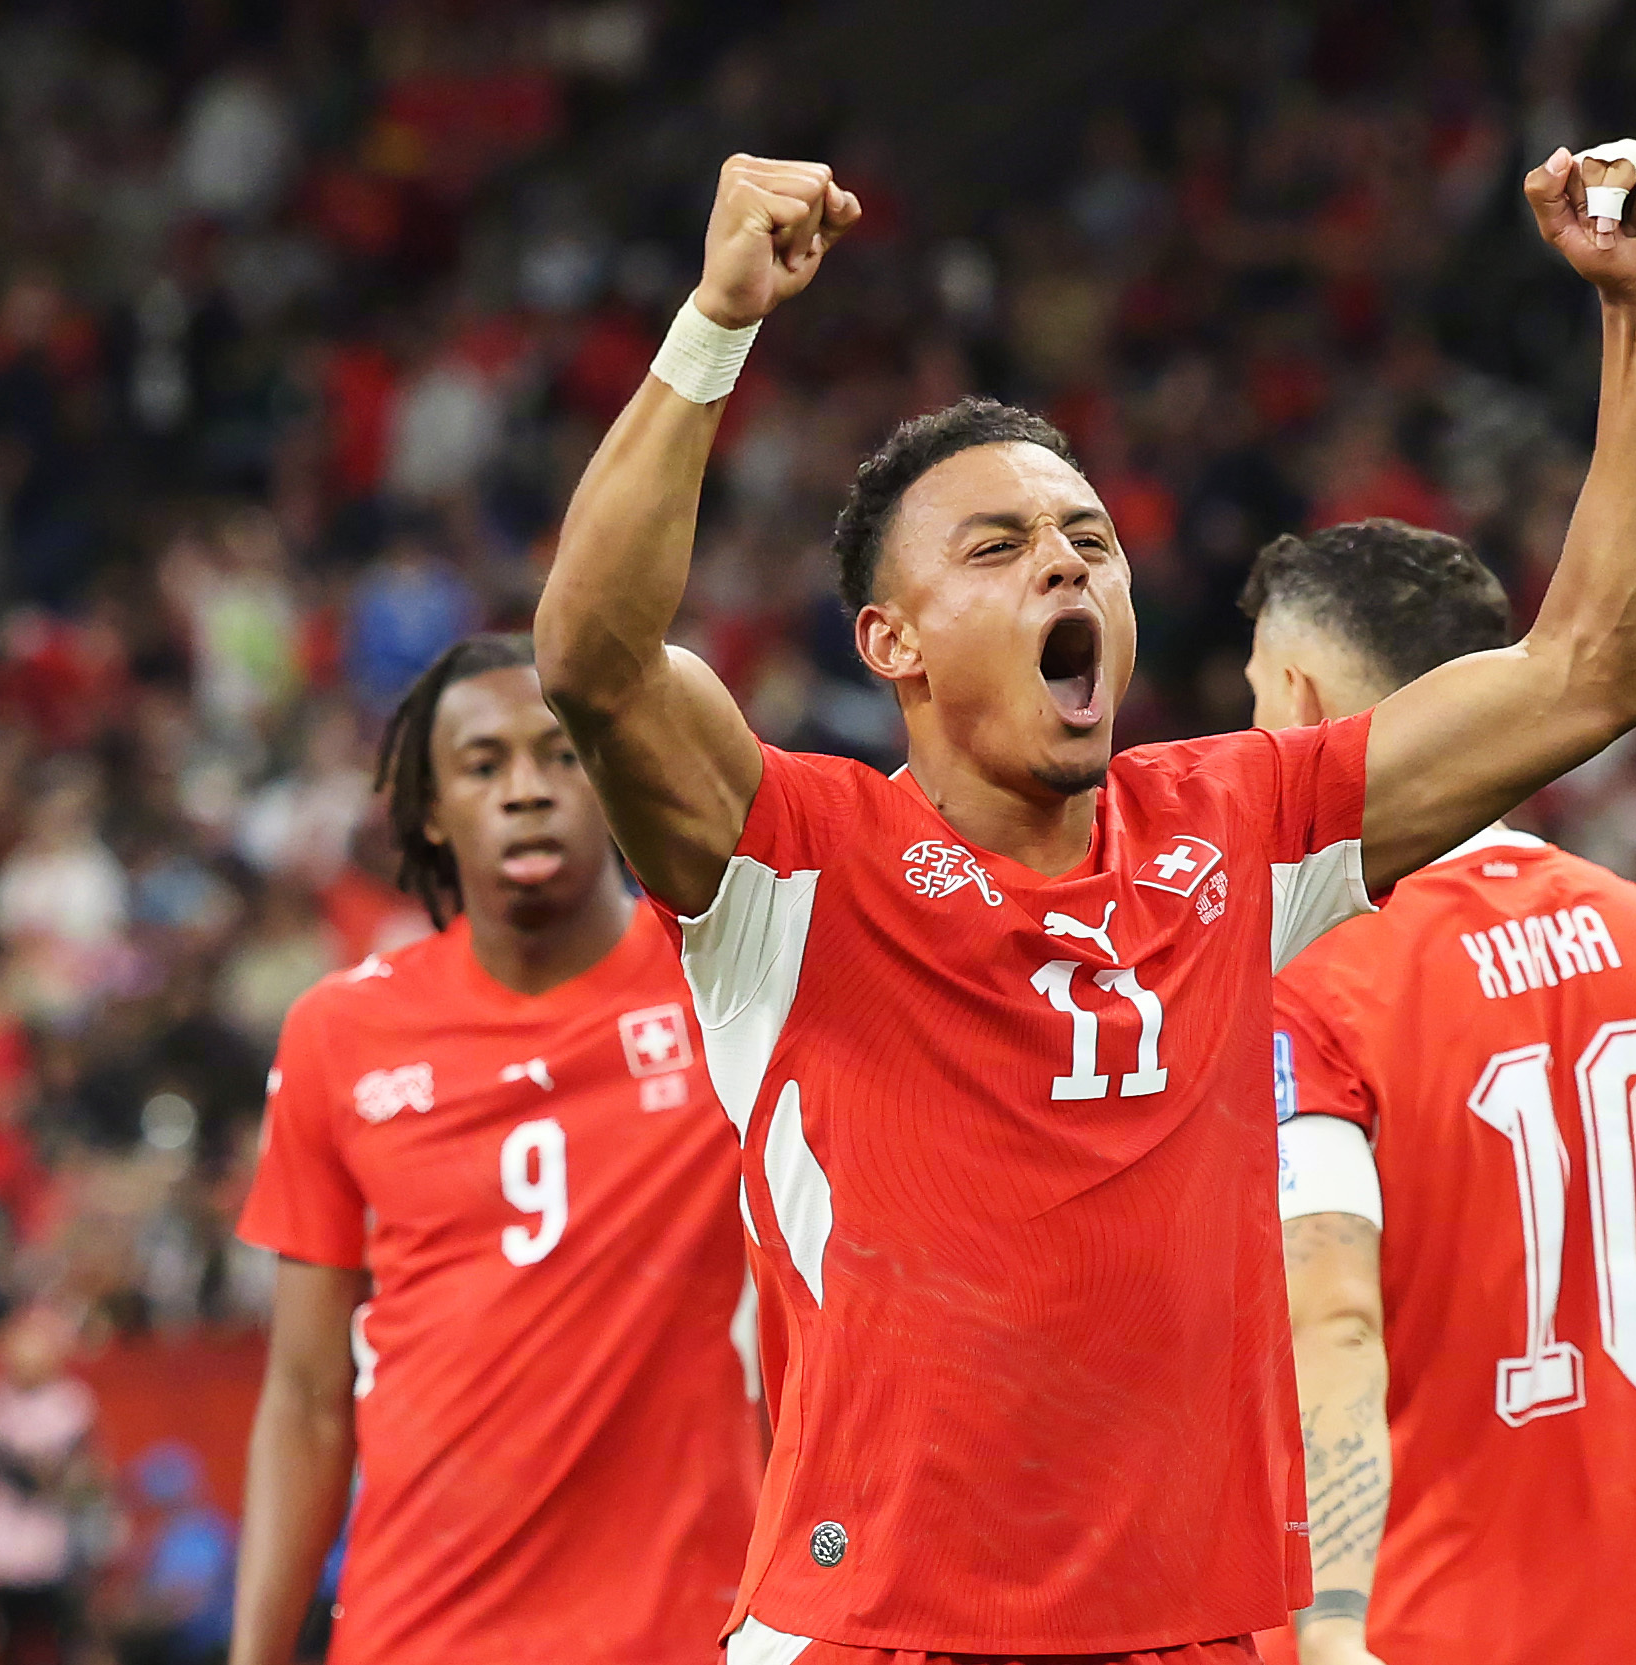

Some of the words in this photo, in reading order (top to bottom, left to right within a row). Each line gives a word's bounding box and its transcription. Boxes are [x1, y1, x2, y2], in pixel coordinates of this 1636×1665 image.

[1460, 905, 1623, 999] XHAKA
[1030, 959, 1168, 1101] 11
[499, 1118, 569, 1267] 9
